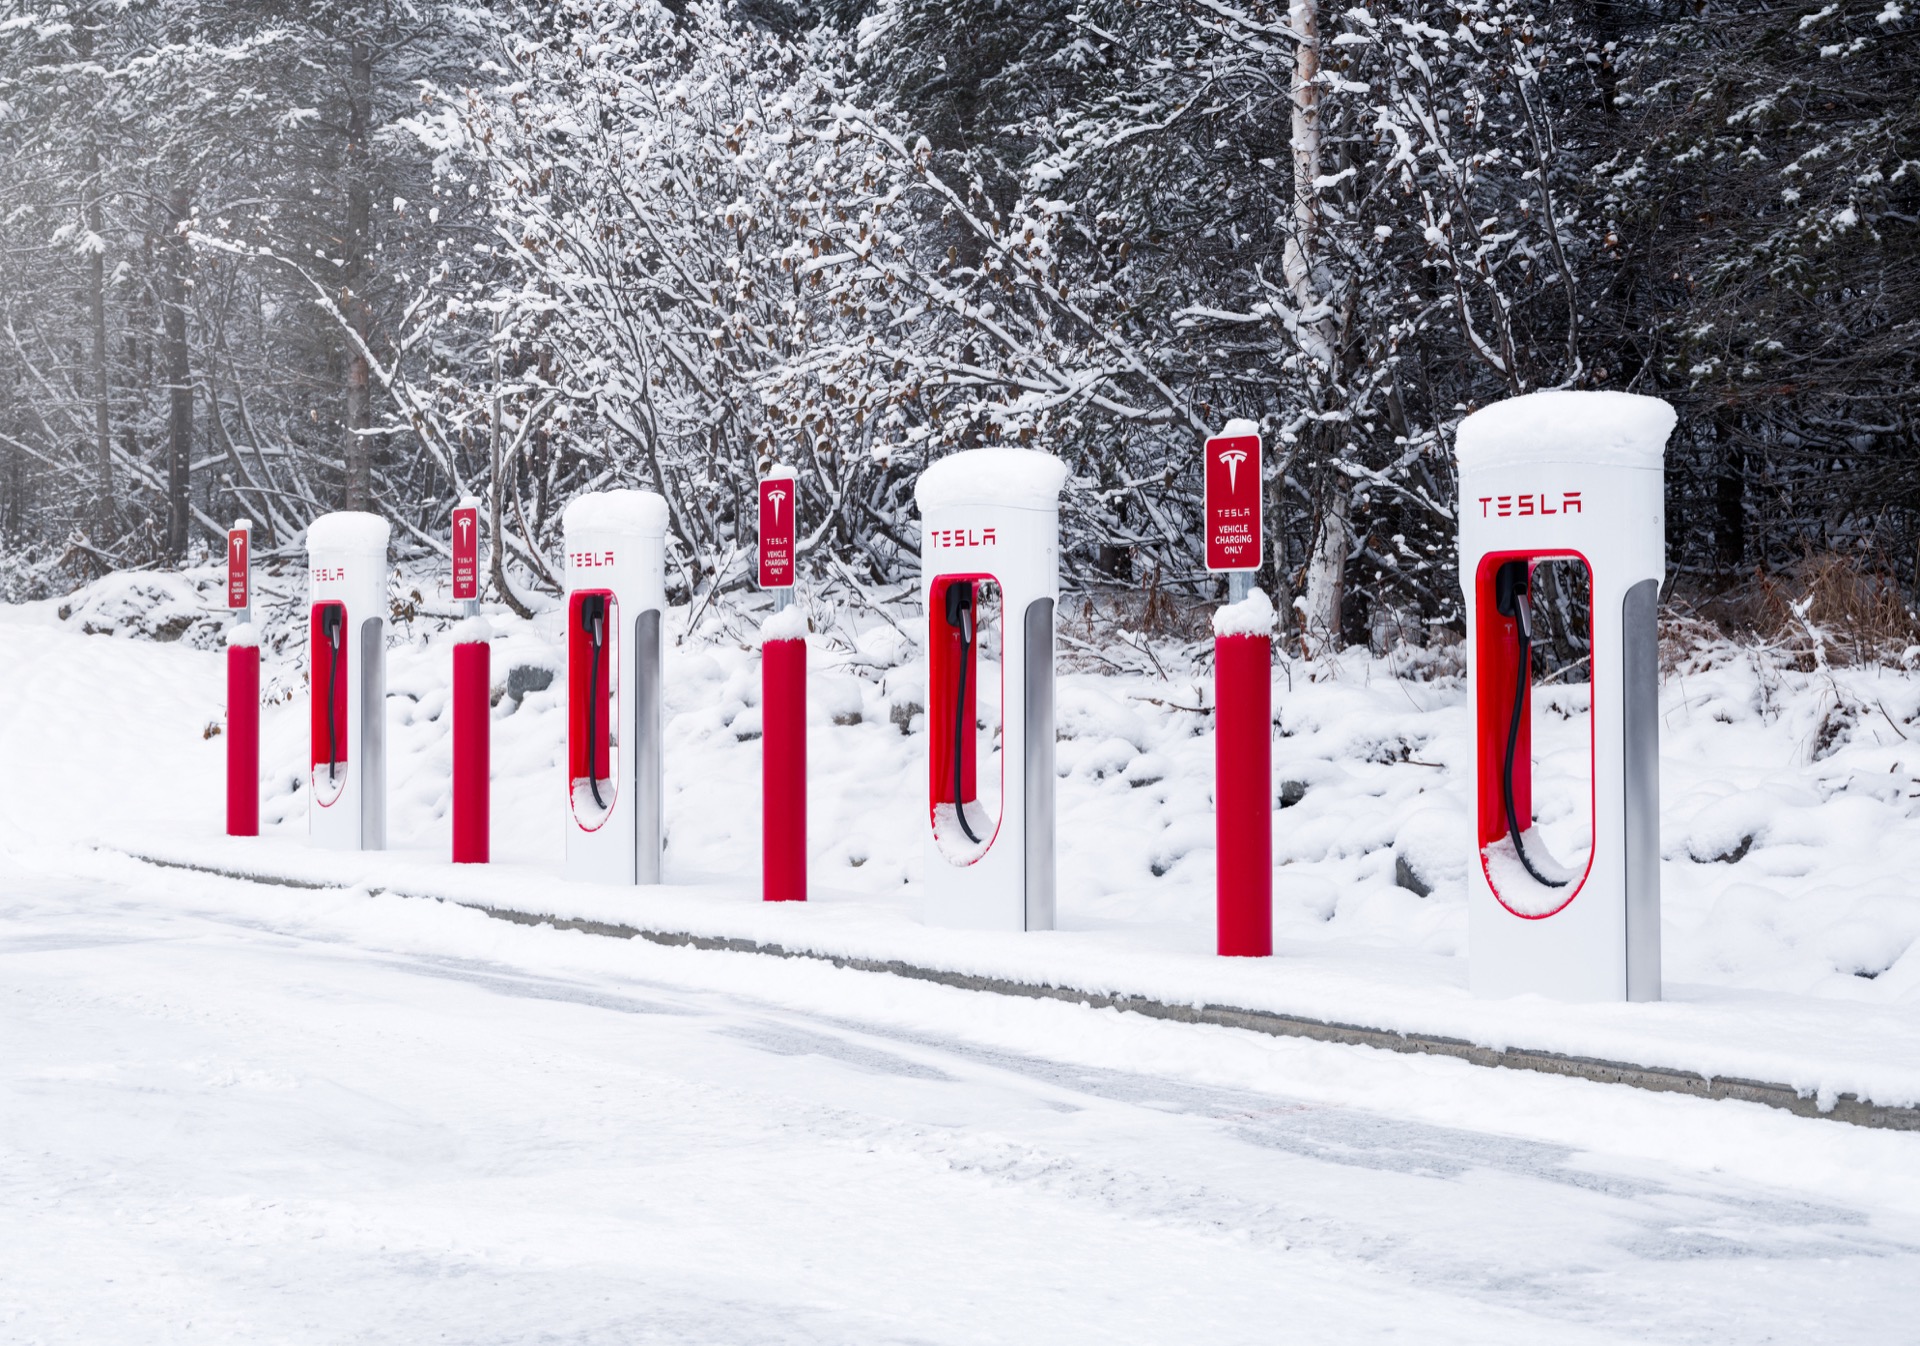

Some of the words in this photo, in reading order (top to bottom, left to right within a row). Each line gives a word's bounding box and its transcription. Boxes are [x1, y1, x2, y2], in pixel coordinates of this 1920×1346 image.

[1478, 491, 1582, 518] TESLA
[1217, 507, 1251, 518] TESLA
[1218, 524, 1249, 534] VEHICLE
[766, 537, 788, 545] TESLA
[931, 527, 996, 548] TESLA
[1215, 534, 1252, 545] CHARGING
[767, 550, 787, 559] VEHICLE
[1224, 545, 1243, 555] ONLY
[570, 551, 614, 568] TESLA
[764, 558, 789, 567] CHARGING
[311, 568, 344, 582] TESLA
[770, 567, 783, 575] ONLY
